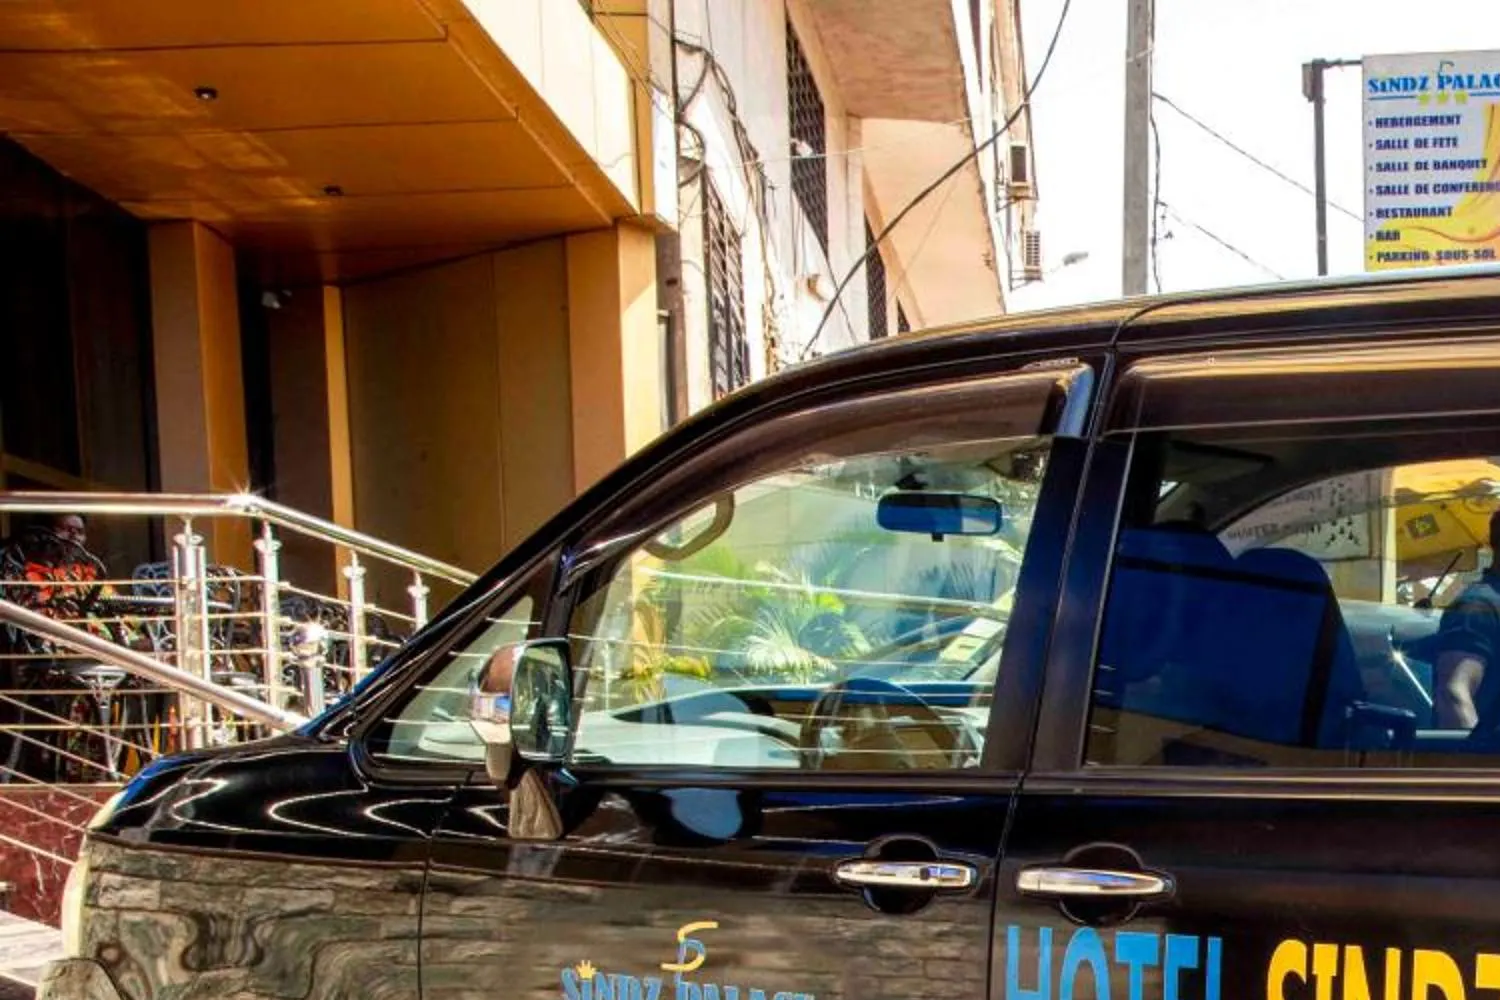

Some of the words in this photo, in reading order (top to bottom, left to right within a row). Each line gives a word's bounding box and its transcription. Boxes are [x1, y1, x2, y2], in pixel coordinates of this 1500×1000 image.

[1375, 139, 1409, 150] SALLE
[1414, 137, 1429, 149] DE
[1375, 161, 1409, 173] SALLE
[1414, 160, 1429, 171] DE
[1433, 158, 1488, 171] BANQUET
[1375, 184, 1409, 196] SALLE
[1414, 183, 1429, 195] DE
[1375, 206, 1453, 218] RESTAURANT
[1375, 230, 1400, 241] BAR
[1377, 250, 1430, 263] PARKING
